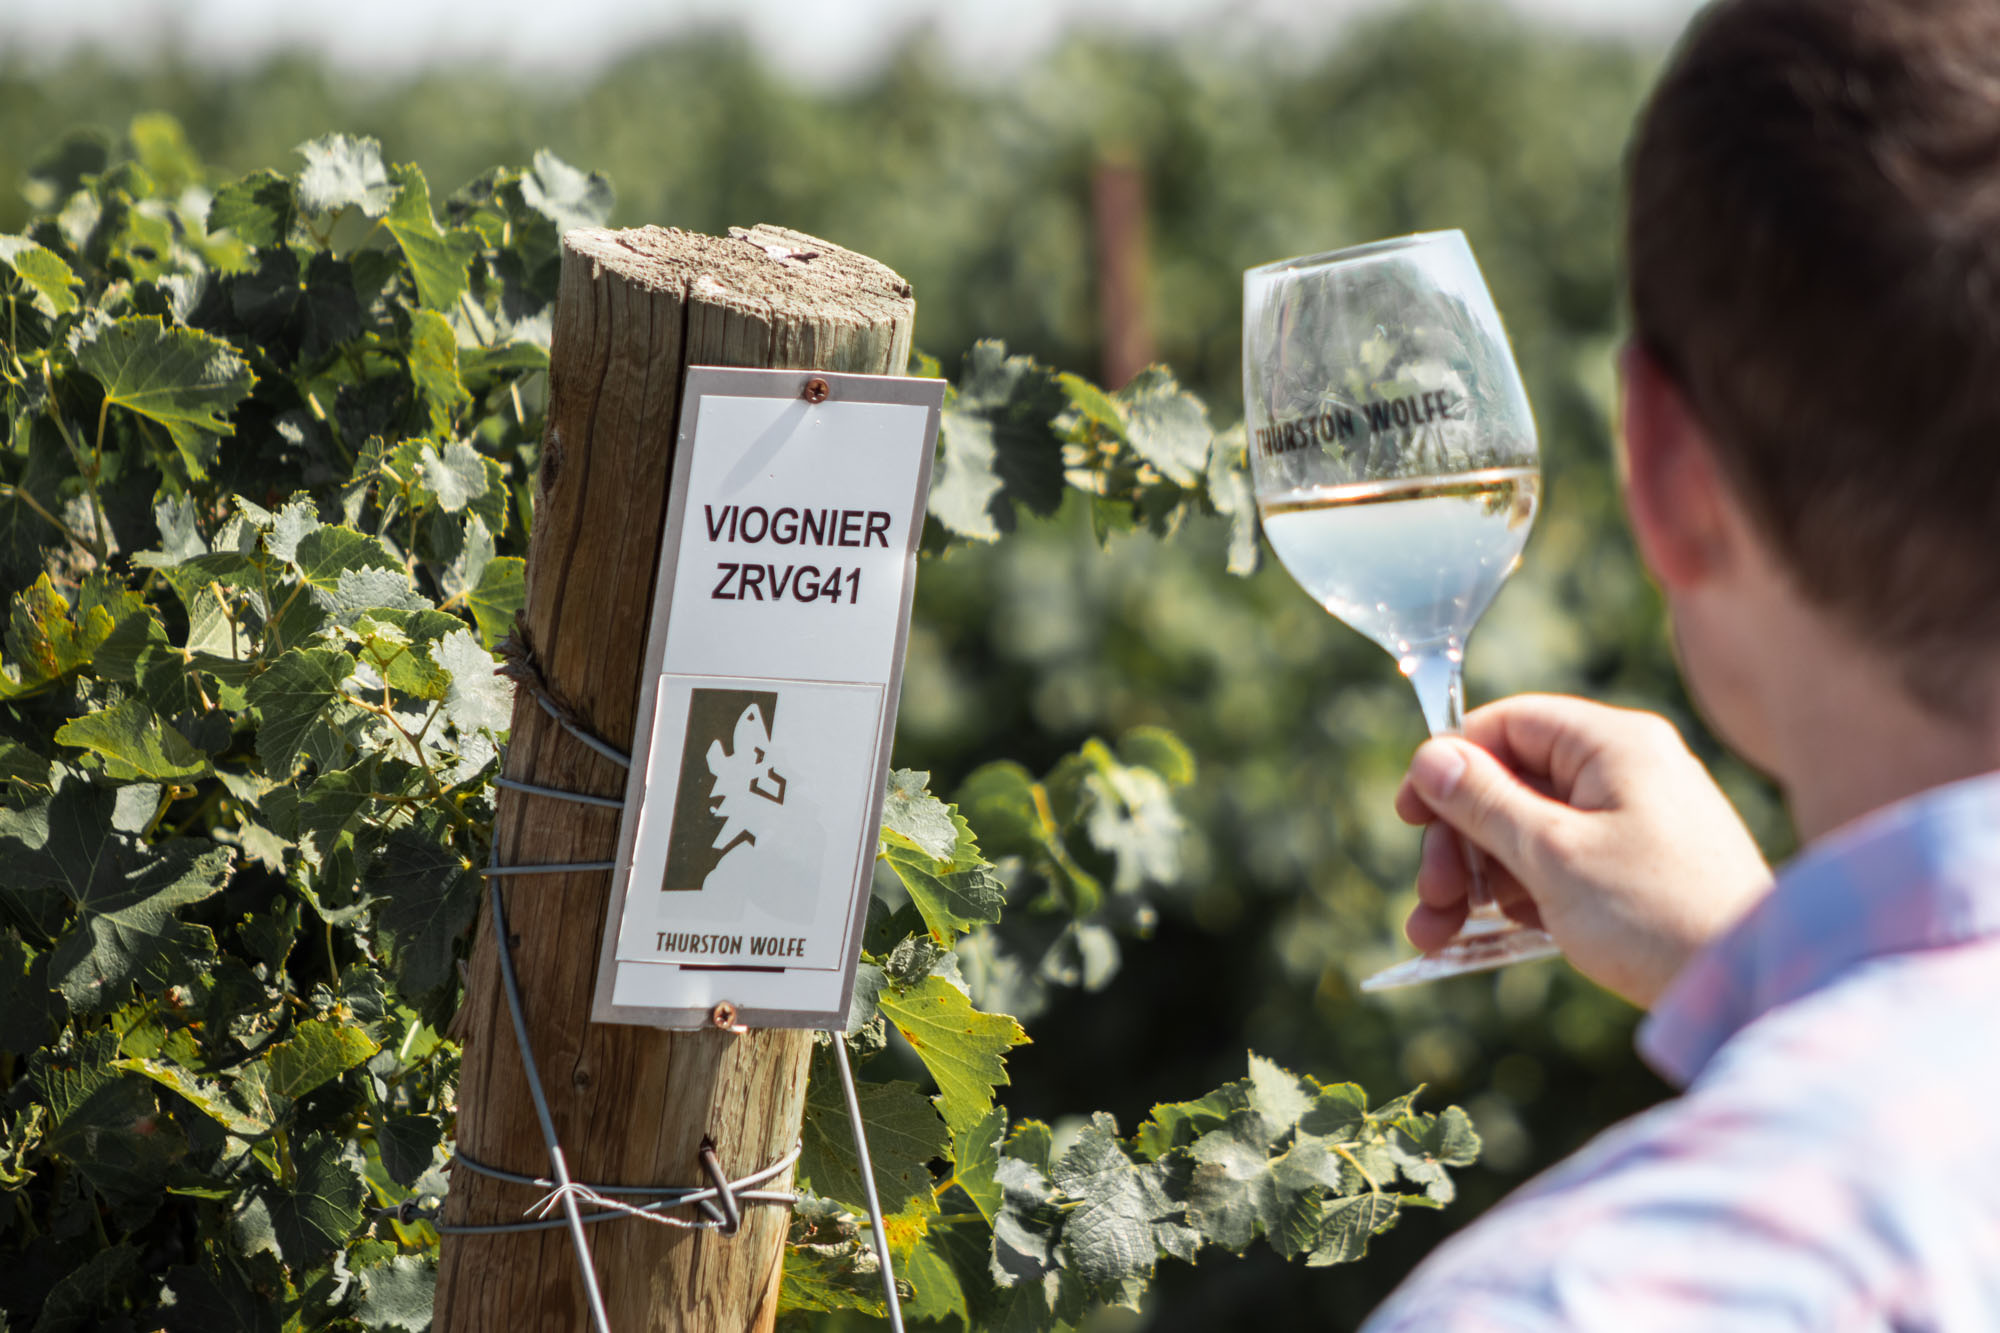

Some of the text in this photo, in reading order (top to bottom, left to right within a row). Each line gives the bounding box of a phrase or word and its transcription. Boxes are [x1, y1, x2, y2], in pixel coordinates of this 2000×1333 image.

[1256, 389, 1450, 459] THURSTON WOLFE
[704, 504, 891, 548] VIOGNIER
[711, 562, 861, 605] ZRVG41
[656, 932, 806, 957] THURSTON WOLFE
